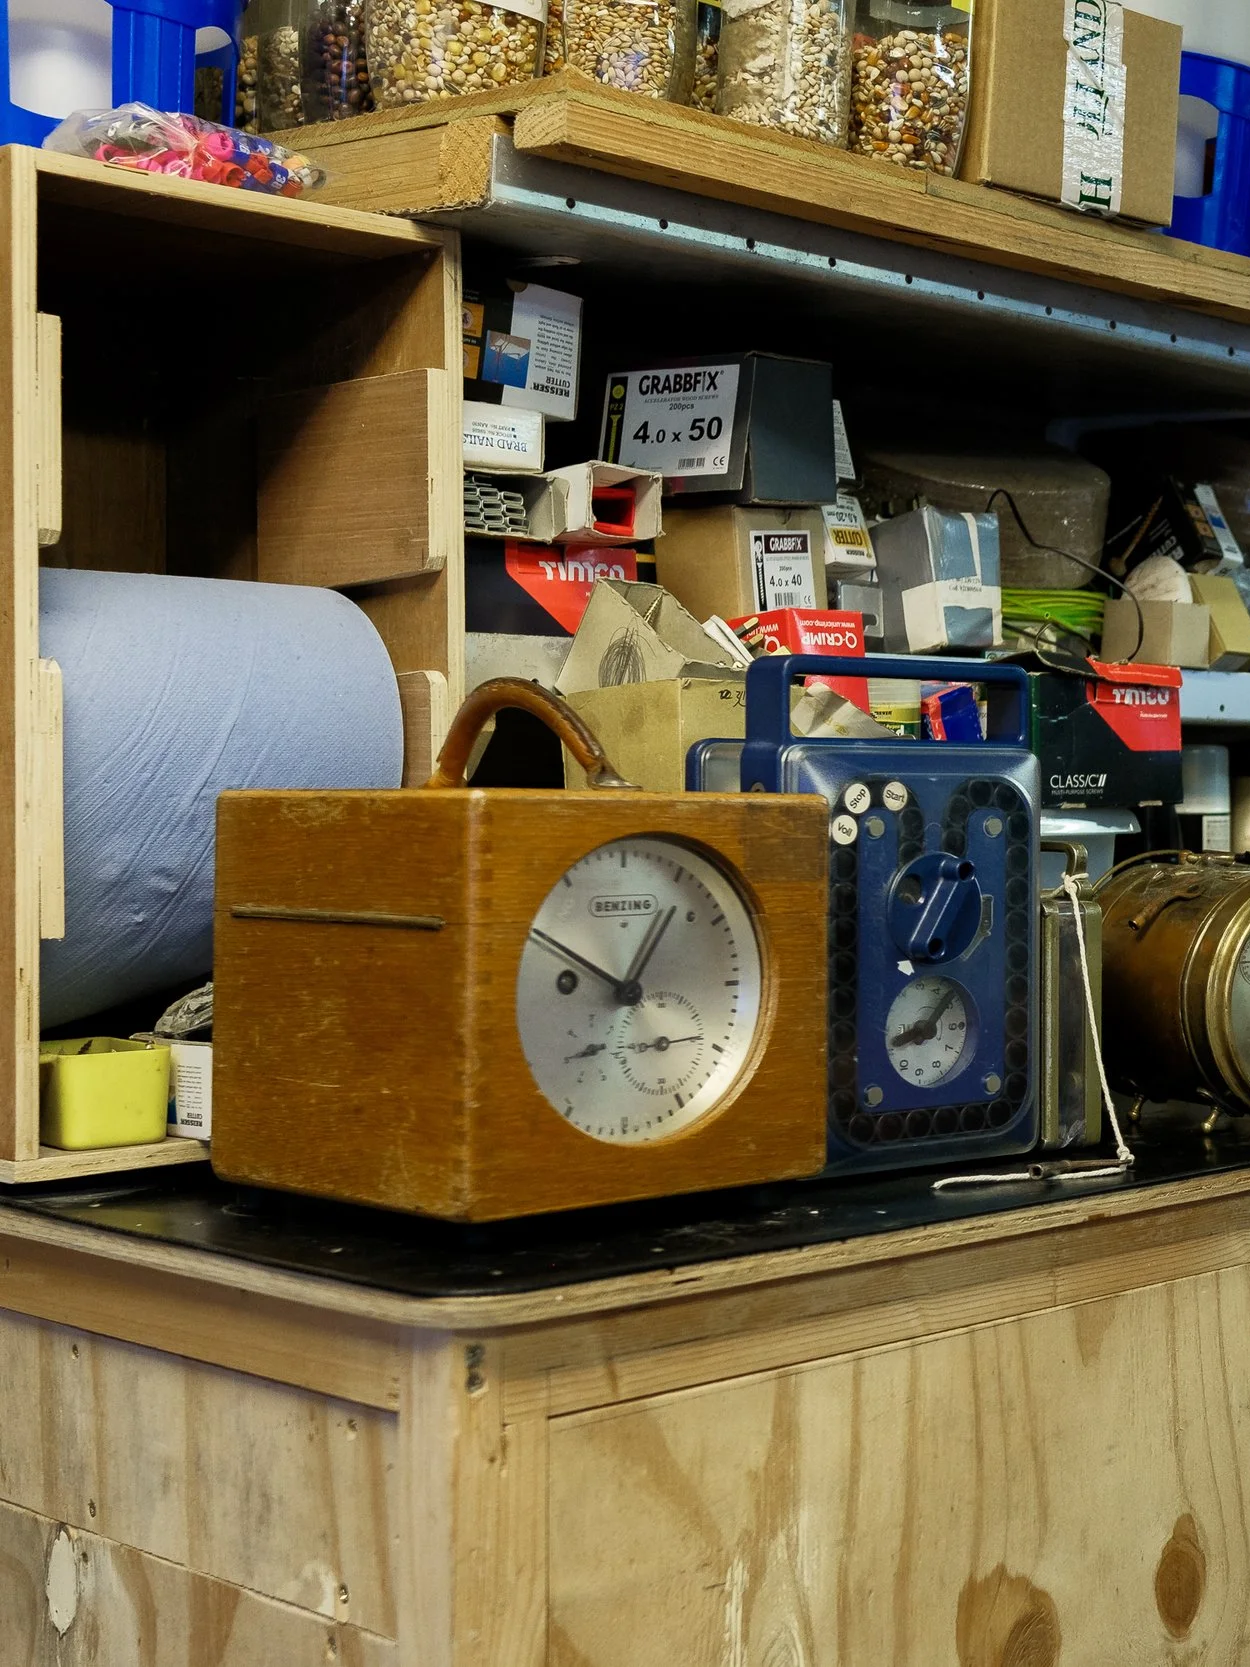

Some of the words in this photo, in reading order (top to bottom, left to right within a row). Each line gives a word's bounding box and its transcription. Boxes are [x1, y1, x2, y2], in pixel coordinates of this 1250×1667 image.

[545, 375, 571, 389] CUTTER
[638, 370, 720, 396] GRABBFIX
[533, 382, 570, 398] REISSER
[669, 402, 695, 412] 200pcs
[632, 420, 666, 445] 4.0
[688, 416, 723, 442] 50
[497, 437, 528, 453] BRAD
[835, 528, 864, 546] CUTTER
[769, 537, 803, 552] GRABBFIX
[769, 575, 783, 587] 4.0
[791, 574, 802, 586] 40
[800, 619, 856, 629] www.unicrimp.com
[801, 631, 858, 649] Q-CRIMP
[849, 788, 867, 810] Stop
[885, 789, 905, 803] Start
[595, 899, 653, 912] BENZING
[899, 1059, 909, 1071] 10
[931, 1059, 941, 1069] 8
